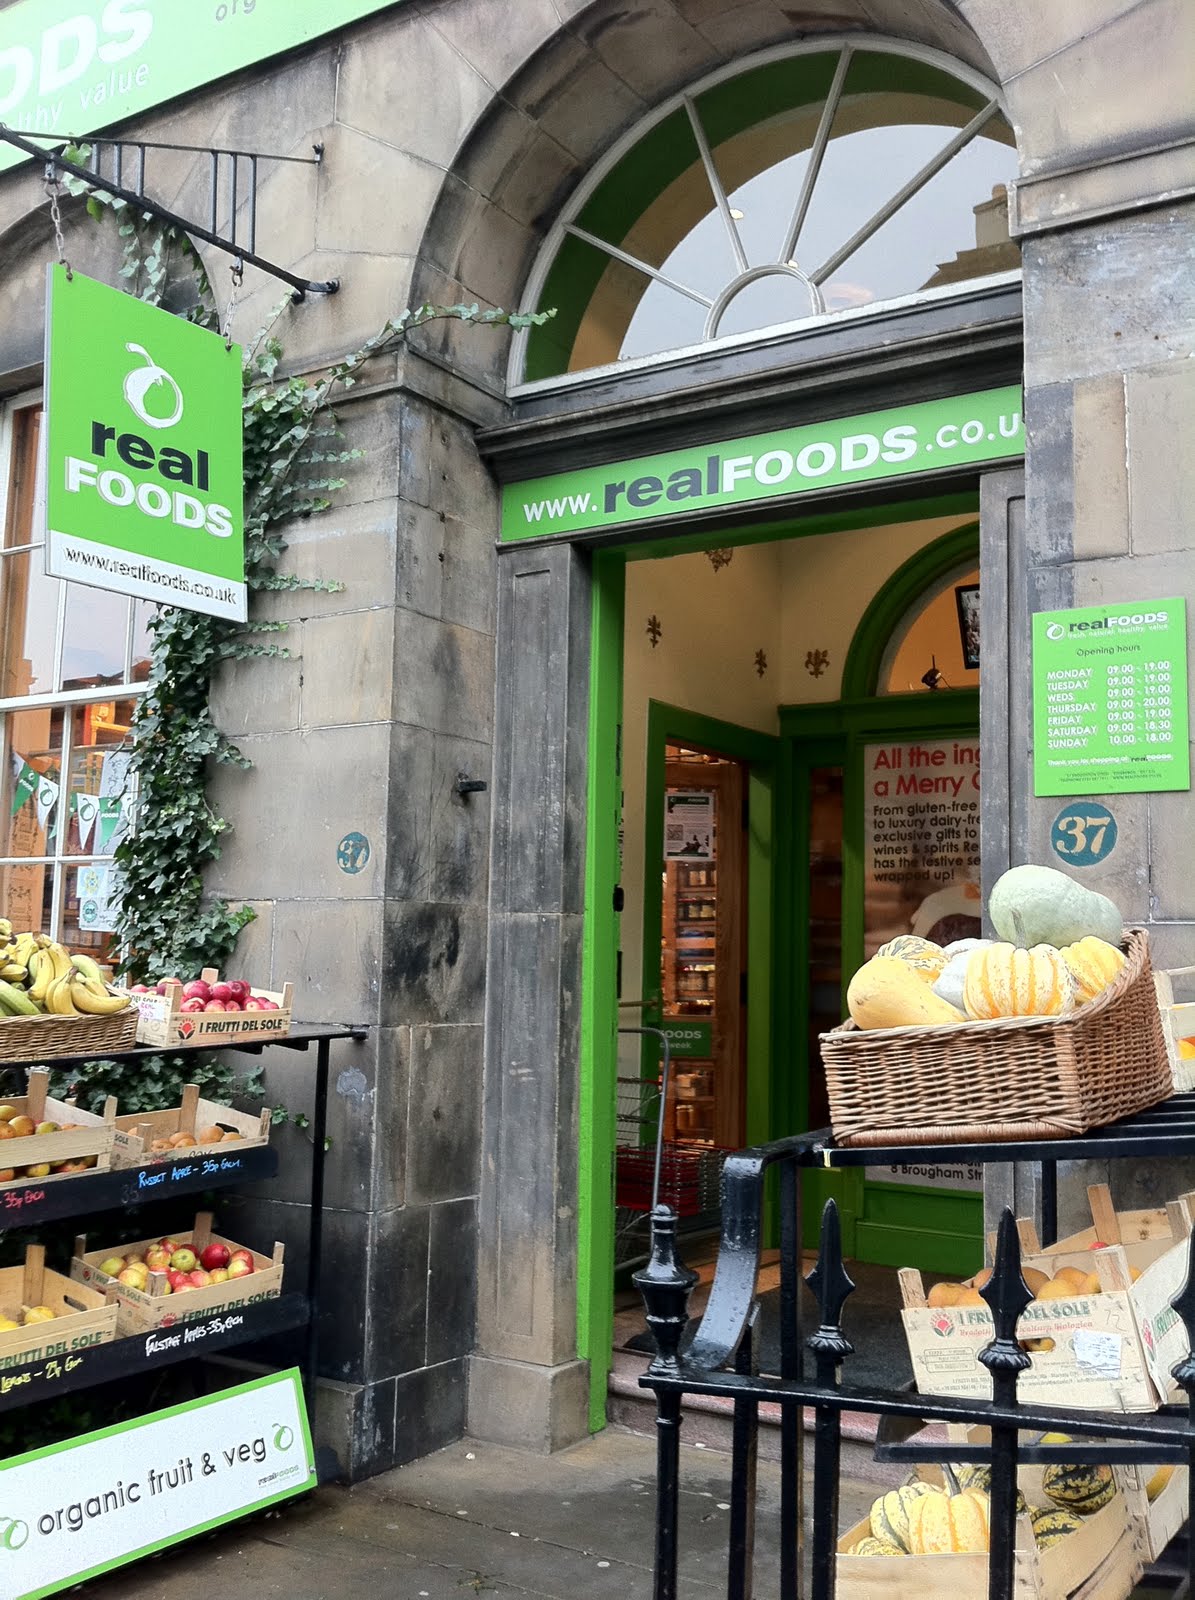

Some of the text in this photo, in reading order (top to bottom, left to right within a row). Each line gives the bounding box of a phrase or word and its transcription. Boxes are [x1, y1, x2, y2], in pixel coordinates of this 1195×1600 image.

[80, 63, 149, 111] value
[91, 421, 209, 492] real
[65, 456, 233, 537] FOODS
[64, 547, 236, 605] www.realfoods.co.uk
[1069, 611, 1168, 632] realFOODS
[1077, 644, 1141, 657] Opening hours
[1047, 668, 1092, 680] MONDAY
[1047, 680, 1089, 691] TUESDAY
[1047, 693, 1073, 702] WEDS
[1047, 702, 1096, 714] THURSDAY
[1047, 715, 1082, 726] FRIDAY
[1047, 726, 1097, 737] SATURDAY
[1047, 738, 1087, 749] SUNDAY
[874, 748, 902, 770] All
[908, 746, 946, 768] the
[873, 781, 889, 797] a
[896, 774, 965, 797] Merry
[873, 802, 977, 817] From gluten-free
[873, 819, 885, 829] to
[889, 817, 926, 829] luxury
[873, 828, 977, 842] exclusive gifts to
[1056, 816, 1111, 854] 37
[873, 845, 907, 855] wines
[912, 844, 920, 853] &
[924, 841, 960, 856] spirits
[873, 858, 895, 868] has
[900, 857, 918, 868] the
[922, 856, 963, 867] festive
[873, 869, 954, 882] wrapped up!
[200, 1018, 283, 1033] I FRUTTI DEL SOLE
[661, 1030, 702, 1039] OODS
[902, 1165, 963, 1180] Brougham
[1052, 1302, 1091, 1320] SOLE
[46, 1341, 68, 1357] DEL
[71, 1332, 102, 1350] SOLE
[37, 1436, 266, 1536] organic fruit & veg
